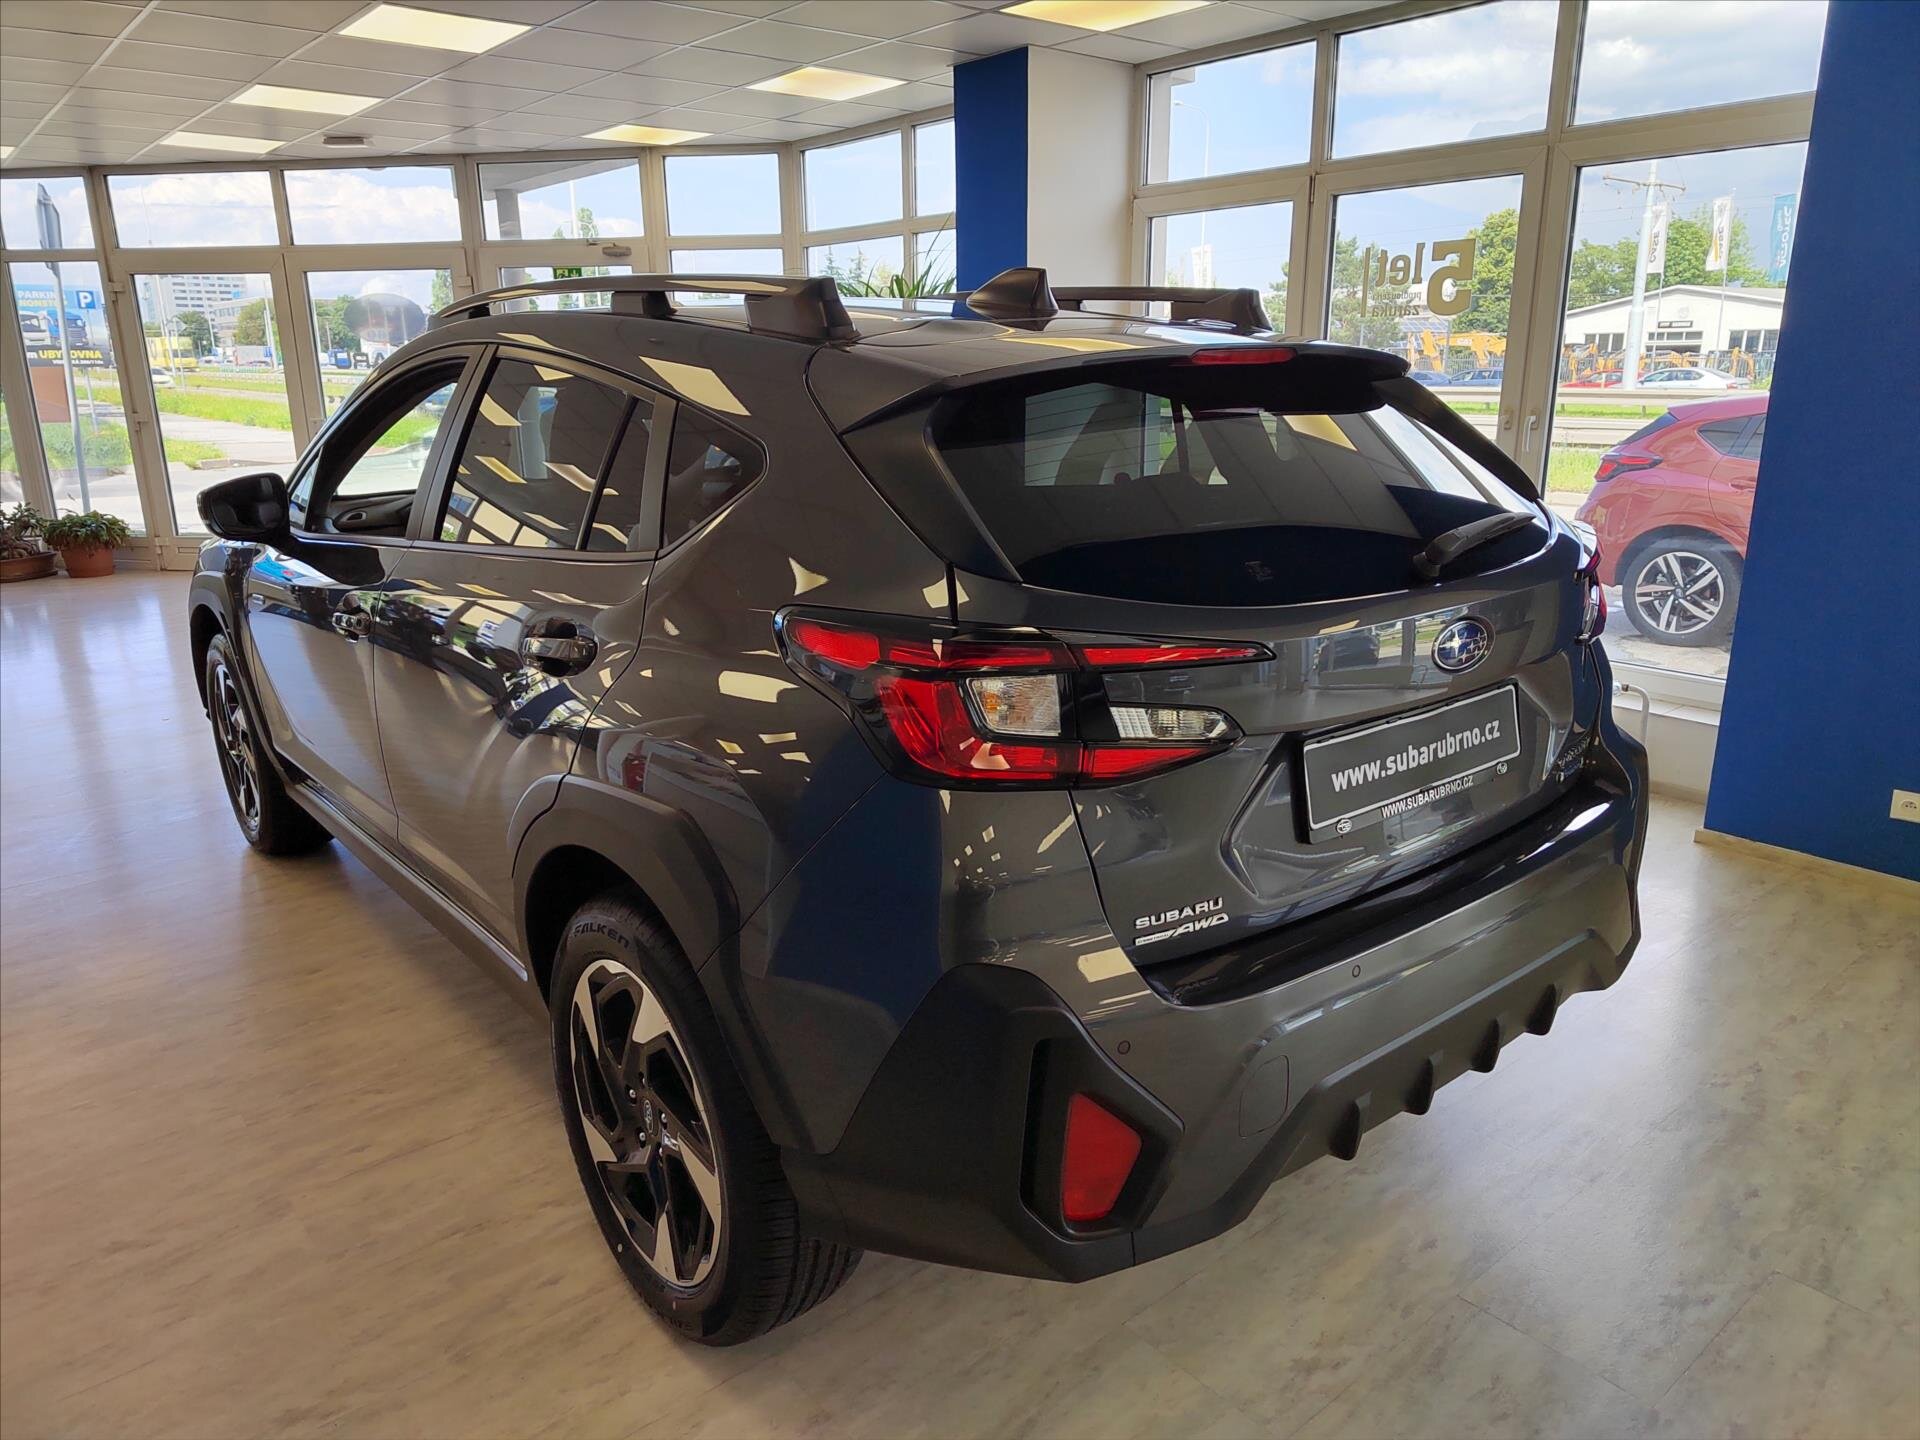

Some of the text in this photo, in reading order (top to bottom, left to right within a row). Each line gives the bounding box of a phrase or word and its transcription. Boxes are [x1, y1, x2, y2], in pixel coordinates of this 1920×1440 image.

[38, 350, 102, 359] UBYOVNA
[1331, 720, 1500, 792] www.subarubrno.cz
[1381, 775, 1473, 818] WWW.SUBARUBRNO.CZ
[1135, 897, 1223, 929] SUBARU
[1172, 912, 1229, 937] AWD
[573, 922, 630, 949] FALKEN
